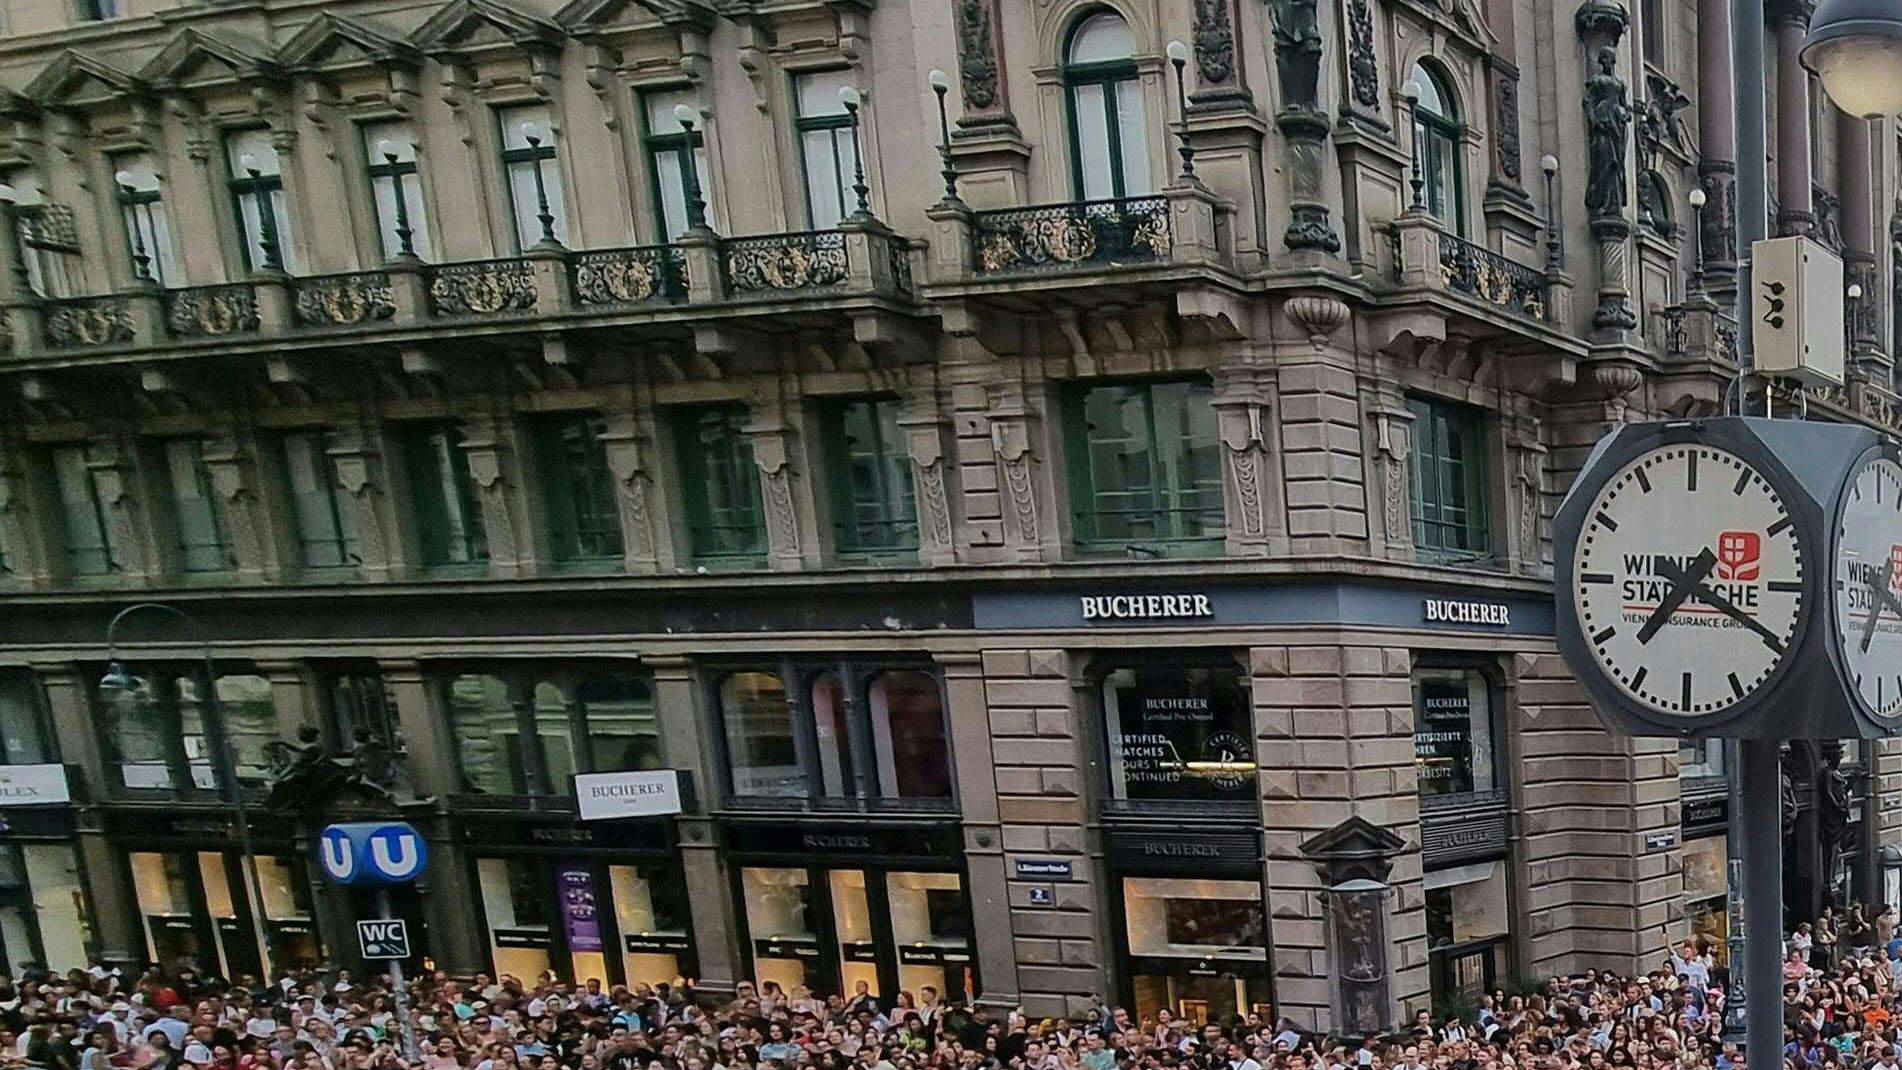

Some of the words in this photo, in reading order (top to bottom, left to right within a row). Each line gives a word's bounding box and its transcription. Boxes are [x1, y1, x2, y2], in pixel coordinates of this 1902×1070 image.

[1081, 594, 1213, 619] BUCHERER
[1426, 599, 1510, 624] BUCHERER
[1666, 614, 1719, 628] NSURANCE
[1146, 699, 1208, 710] BUCHERER
[1121, 759, 1150, 770] OURS
[1123, 771, 1181, 783] ONTINUED
[592, 783, 665, 798] BUCHERER
[322, 836, 353, 878] U
[370, 834, 418, 877] U
[1143, 842, 1220, 857] BUCHERER
[362, 923, 403, 941] WC
